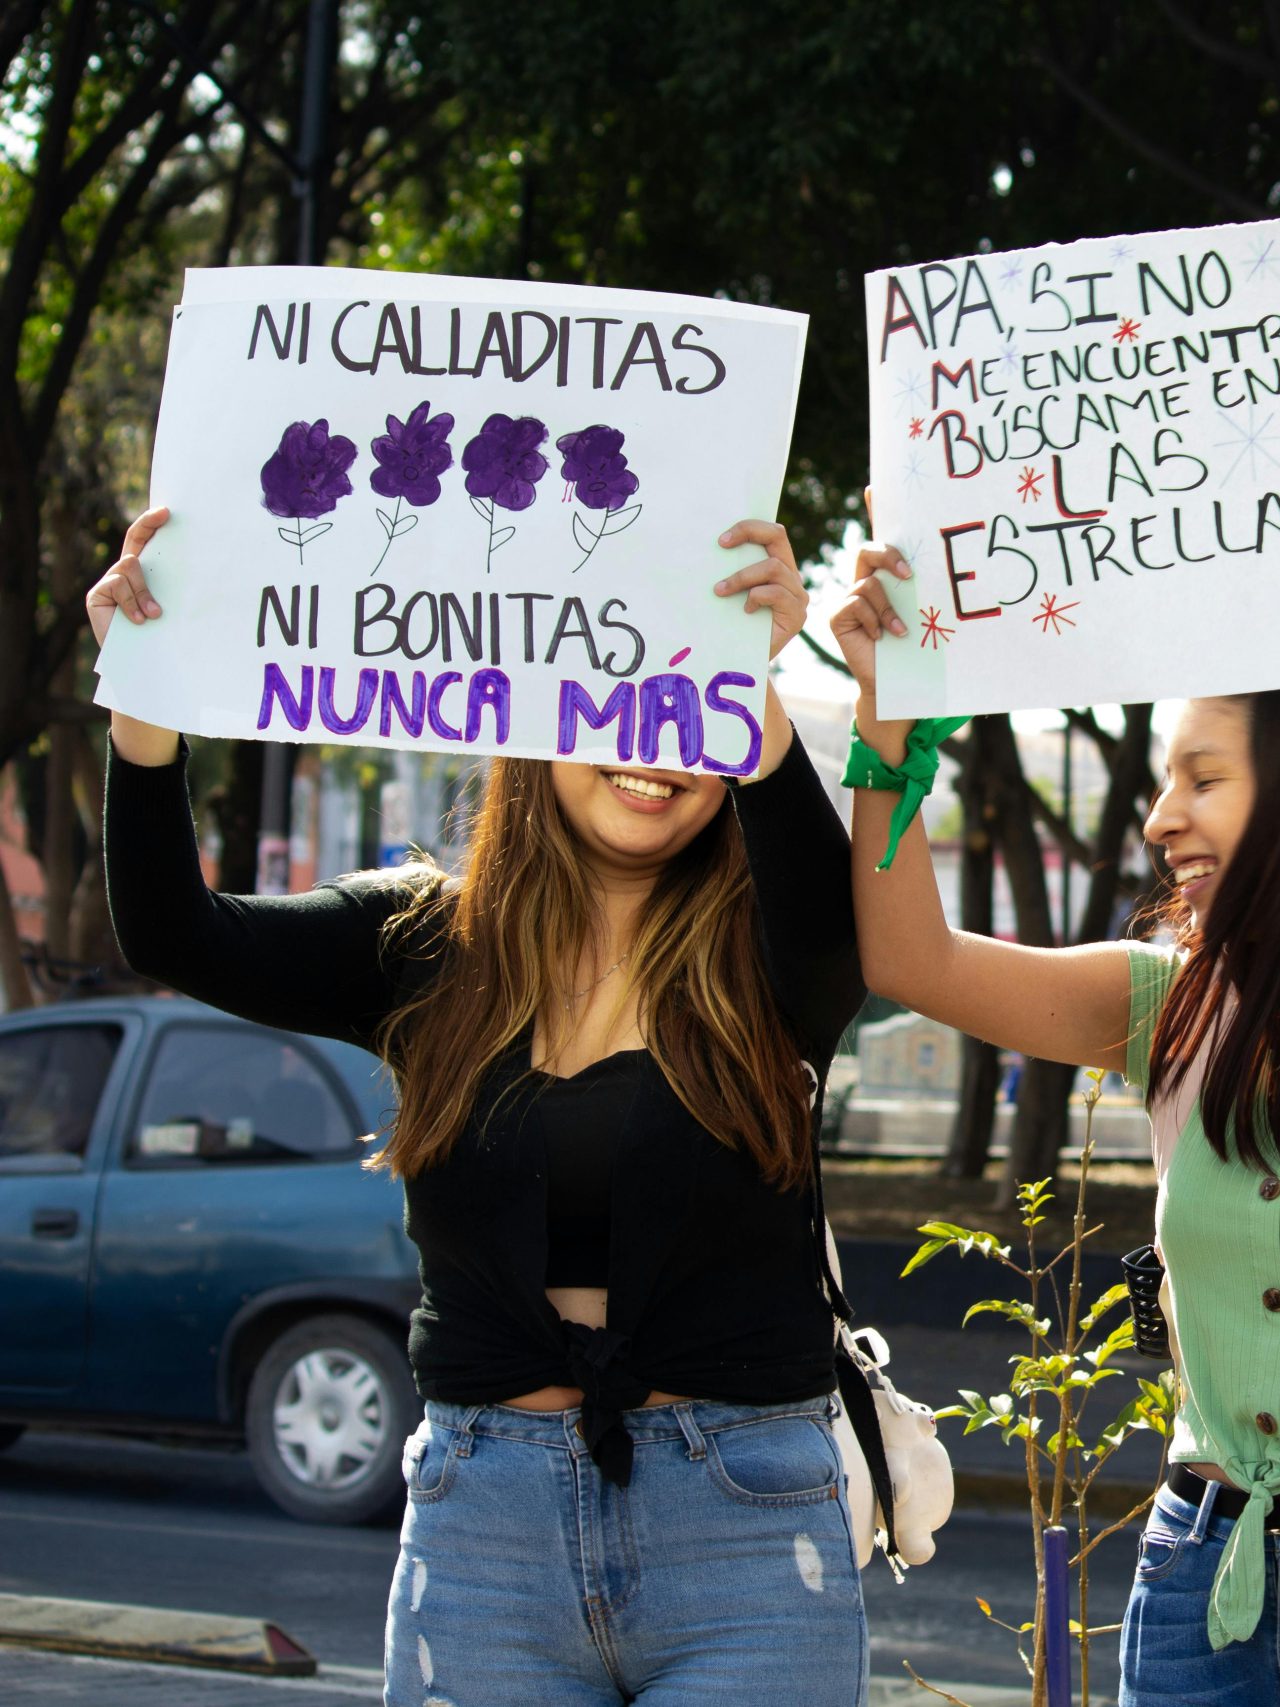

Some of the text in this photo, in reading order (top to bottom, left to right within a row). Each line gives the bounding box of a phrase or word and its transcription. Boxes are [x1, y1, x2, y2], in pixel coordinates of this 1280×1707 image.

[247, 300, 727, 395] NI CALLADITAS
[881, 250, 1233, 363] APA, SI NO
[930, 357, 1008, 410] ME
[1051, 428, 1210, 520] LAS
[256, 583, 647, 678] NI BONITAS
[256, 646, 764, 777] NUNCA MÁS
